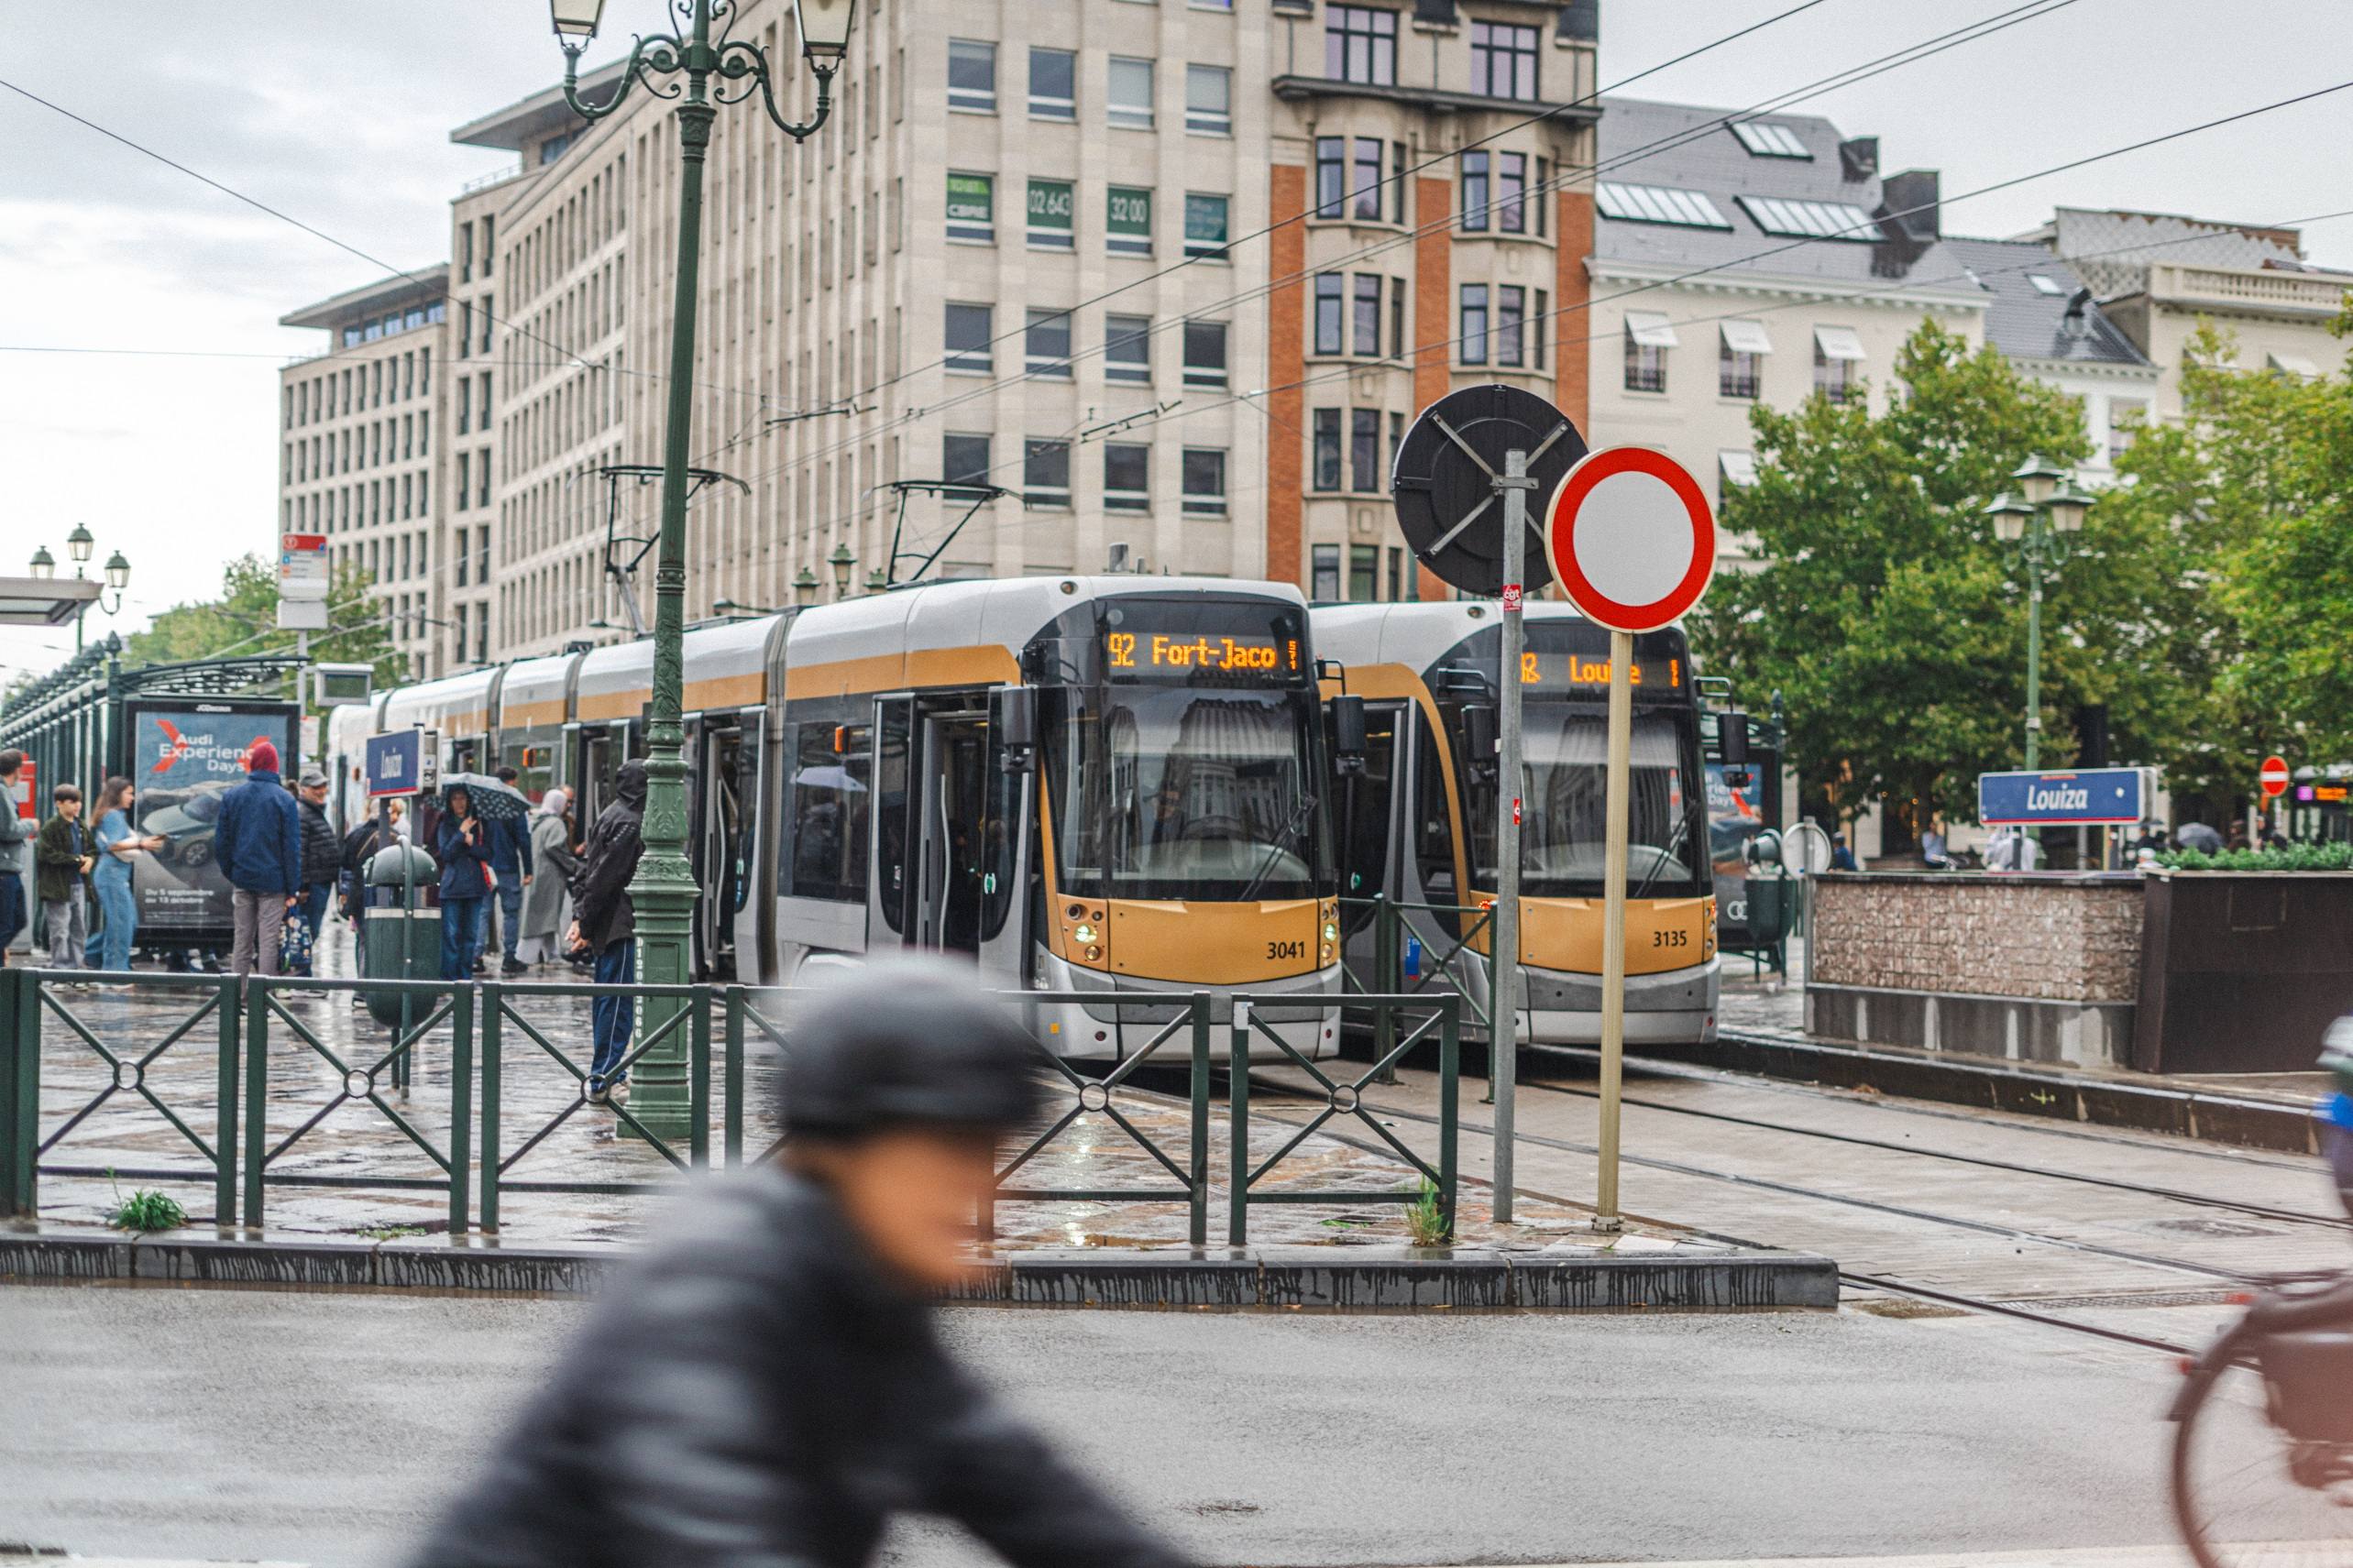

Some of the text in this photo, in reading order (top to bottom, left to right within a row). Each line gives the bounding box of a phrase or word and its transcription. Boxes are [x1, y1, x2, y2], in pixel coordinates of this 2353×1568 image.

[1028, 189, 1071, 215] 02 643
[1111, 196, 1148, 223] 32 00
[1108, 632, 1277, 671] 92 Fort-Jaco
[176, 734, 214, 746] Audi
[159, 743, 255, 762] Experienc
[206, 760, 246, 773] Days
[2027, 783, 2089, 811] Louiza
[1653, 930, 1688, 948] 3135
[1267, 940, 1305, 959] 3041
